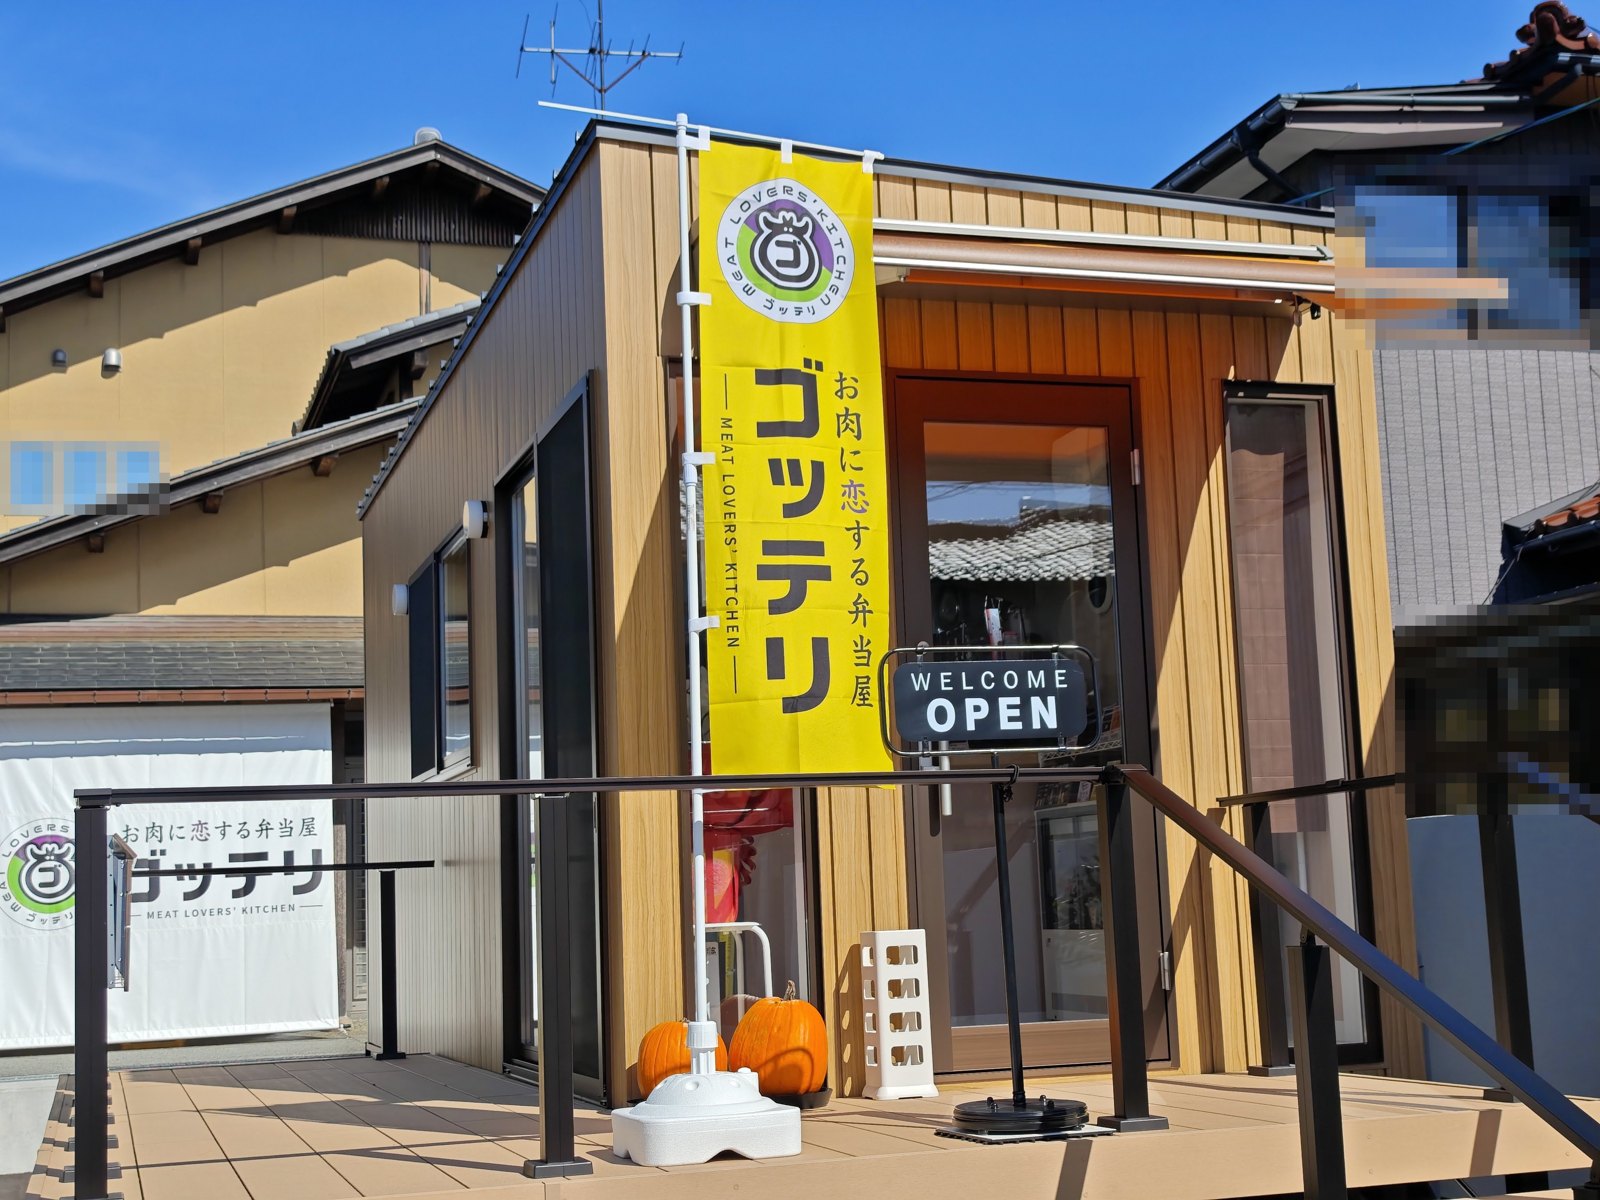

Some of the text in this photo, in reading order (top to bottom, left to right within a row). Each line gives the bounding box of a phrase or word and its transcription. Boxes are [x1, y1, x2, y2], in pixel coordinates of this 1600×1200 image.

[724, 237, 756, 297] MEAT
[816, 209, 847, 306] KITCHEN
[763, 298, 816, 316] ゴッテリ
[720, 417, 740, 648] MEAT LOVERS' KITCHEN
[755, 357, 832, 714] ゴッテリ
[834, 371, 874, 708] お肉に恋する弁当屋
[911, 669, 1068, 691] WELCOME
[926, 696, 1058, 733] OPEN
[122, 817, 318, 844] お肉に恋する弁当屋
[131, 849, 323, 903] ゴッテリ
[147, 904, 295, 919] MEAT LOVERS' KITCHEN
